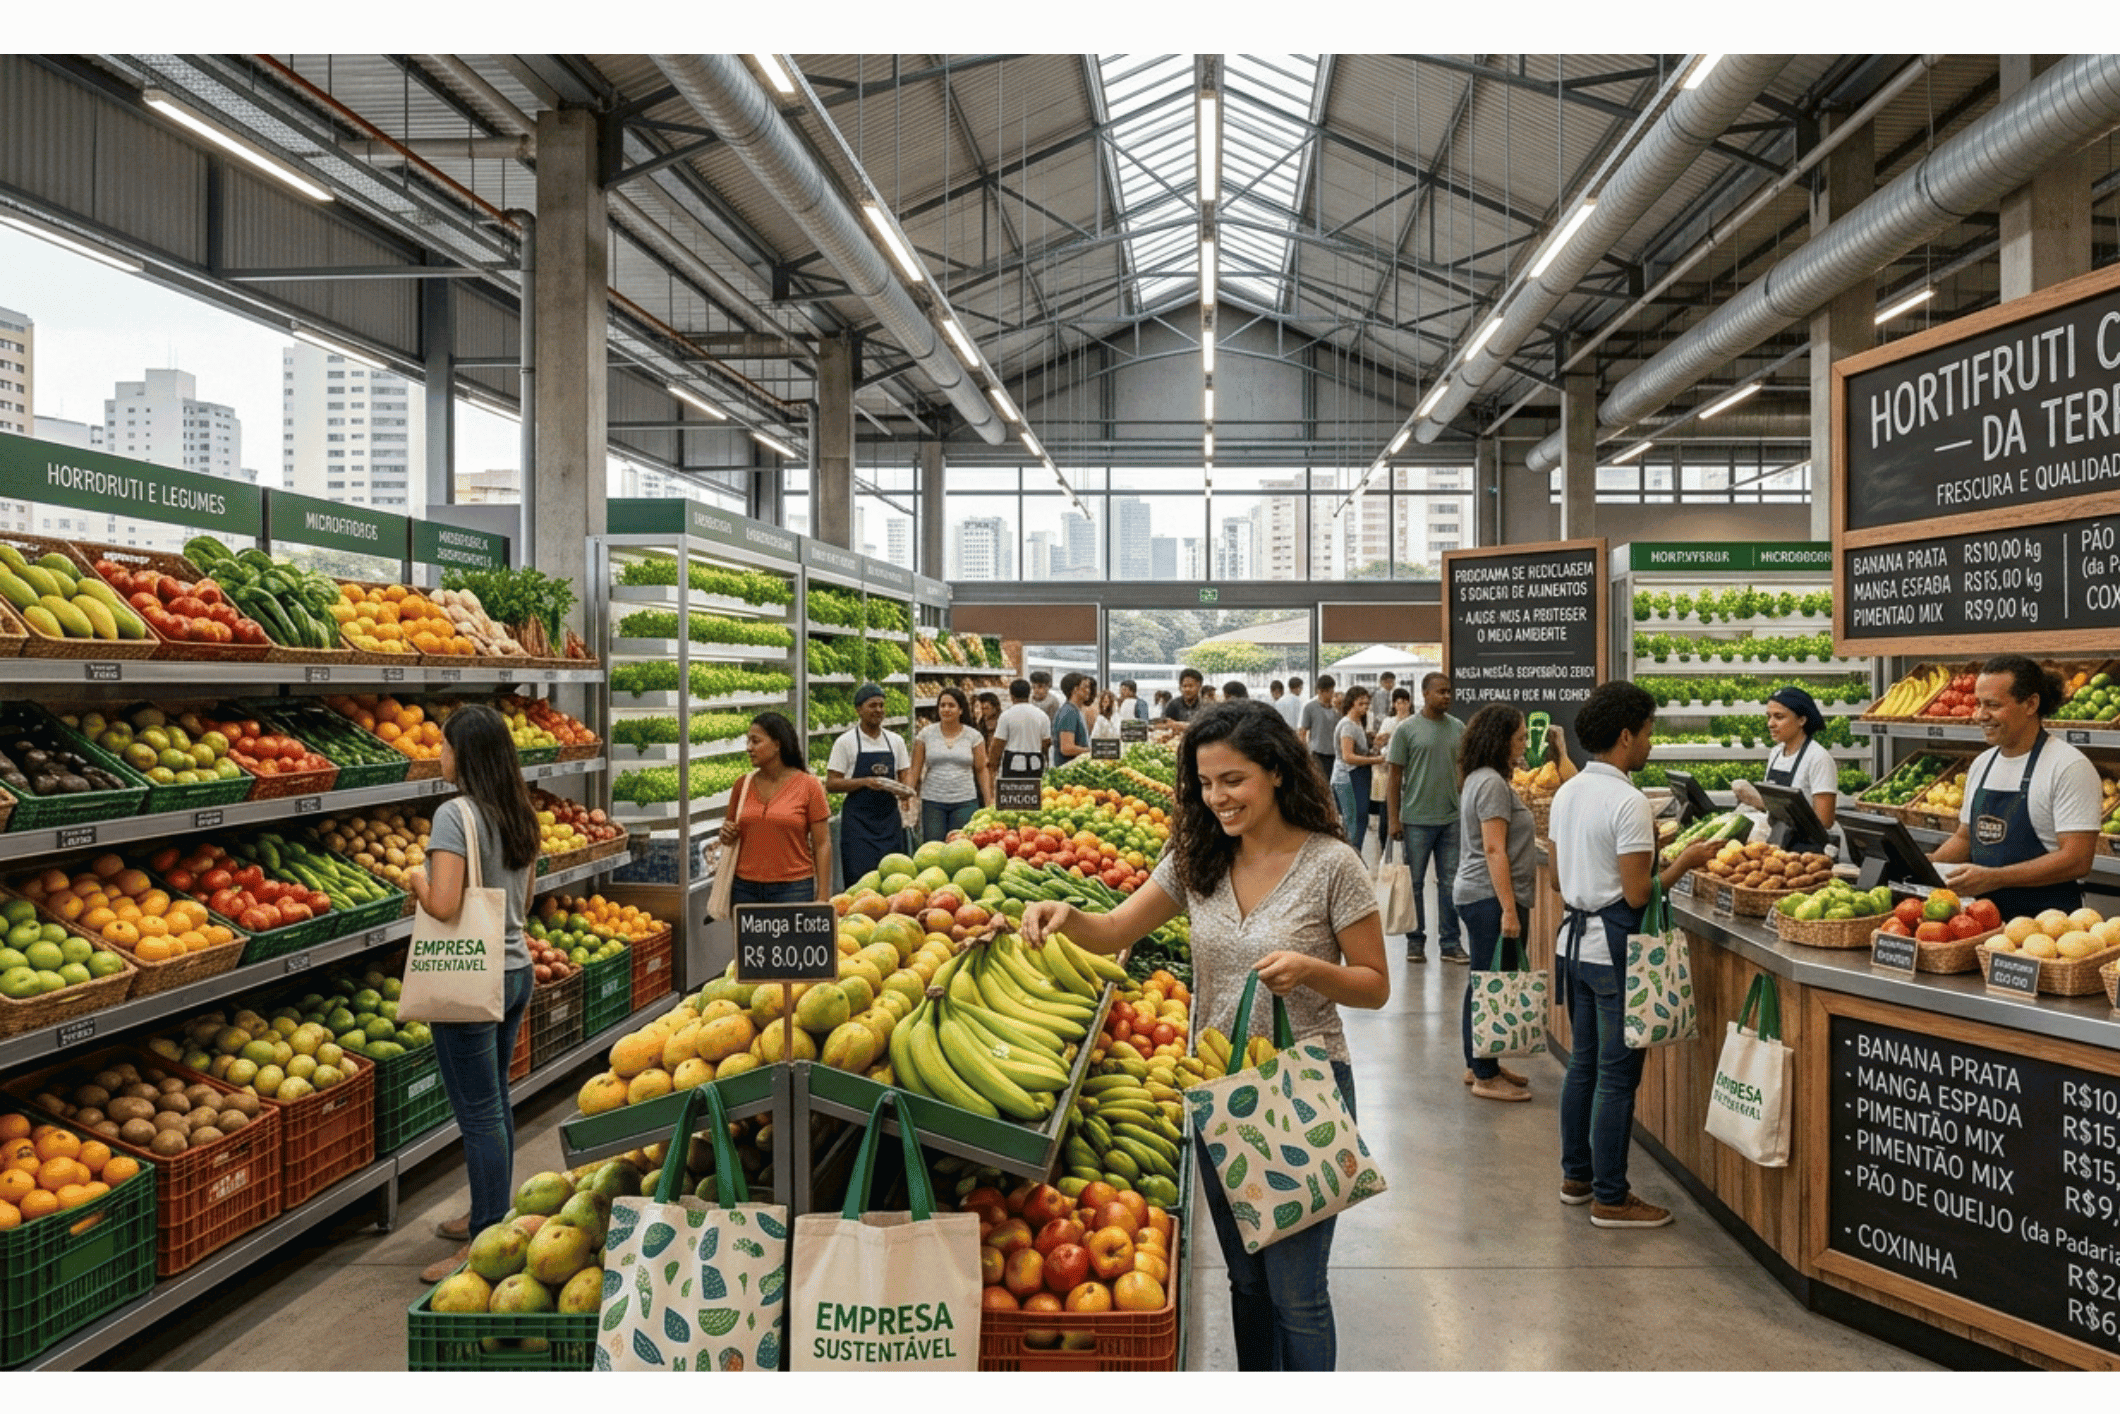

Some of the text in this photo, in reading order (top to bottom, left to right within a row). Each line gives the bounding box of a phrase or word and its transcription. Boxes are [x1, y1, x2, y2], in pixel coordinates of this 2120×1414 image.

[1870, 311, 2120, 449] HORTIFRUTI C
[1982, 408, 2027, 462] DA
[148, 482, 157, 503] E
[162, 484, 226, 515] LEGUMES
[1937, 472, 2013, 505] FRESCURA
[2020, 468, 2029, 492] E
[2081, 522, 2115, 553] PÃO
[1853, 552, 1904, 576] BANANA
[1907, 546, 1948, 570] PRATA
[2025, 537, 2042, 562] kg
[2081, 556, 2105, 579] (da
[1853, 579, 1899, 601] MANGA
[2026, 567, 2043, 592] kg
[2021, 597, 2038, 622] kg
[1477, 628, 1486, 643] O
[741, 914, 791, 938] Manga
[413, 939, 487, 956] EMPRESA
[744, 945, 766, 969] R$
[1858, 1034, 1944, 1076] BANANA
[1951, 1054, 2021, 1094] PRATA
[1858, 1066, 1932, 1105] MANGA
[1938, 1085, 2023, 1129] ESPADA
[1857, 1097, 1958, 1144] PIMENTÃO
[1965, 1124, 2005, 1158] MIX
[1857, 1129, 2120, 1228] PIMENTÃO MIX R$9,
[1857, 1164, 1896, 1197] PÃO
[1902, 1178, 1928, 1208] DE
[1934, 1188, 2014, 1234] QUEIJO
[2020, 1215, 2050, 1245] (da
[1857, 1223, 1958, 1280] COXINHA
[2068, 1263, 2120, 1301] R$2
[816, 1301, 954, 1335] EMPRESA
[813, 1336, 957, 1362] SUSTENTÁVEL
